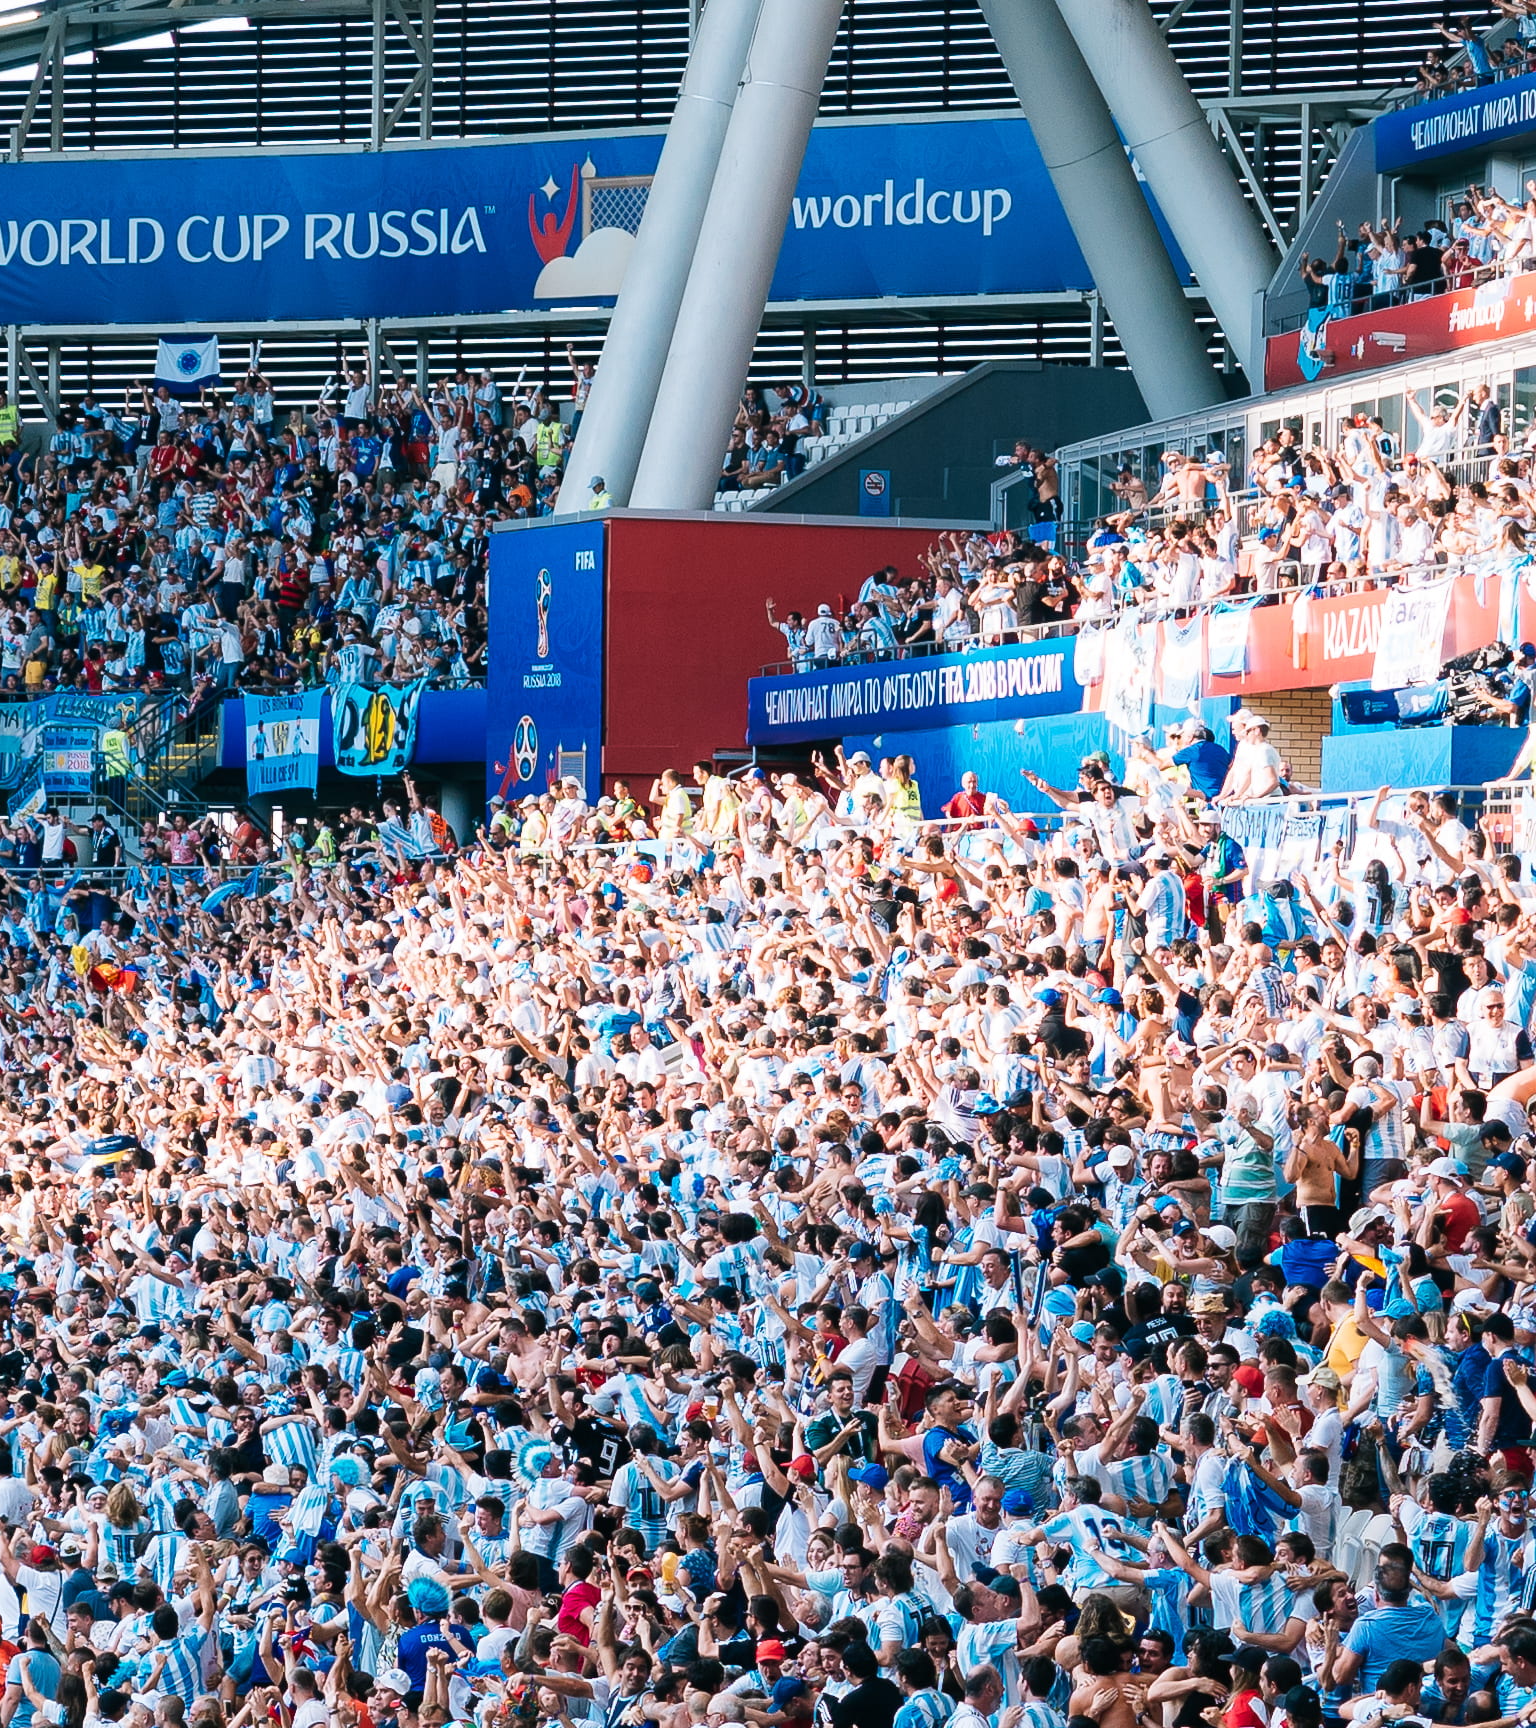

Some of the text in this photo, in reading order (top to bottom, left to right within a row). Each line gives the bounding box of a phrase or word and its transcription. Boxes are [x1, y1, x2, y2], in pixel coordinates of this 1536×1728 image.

[1410, 105, 1479, 150] ЧЕМПИОНАТ
[1481, 95, 1515, 133] МИРА
[176, 212, 289, 262] CUP
[574, 551, 595, 570] FIFA
[523, 673, 545, 689] RUSSIA
[764, 650, 1065, 726] ЧЕМПИОНАТ МИРА ПО ФУТБОЛУ FIFA 2018 В РОССИИ
[67, 760, 90, 770] 2018
[599, 1440, 619, 1474] 9
[1418, 1538, 1454, 1582] 10
